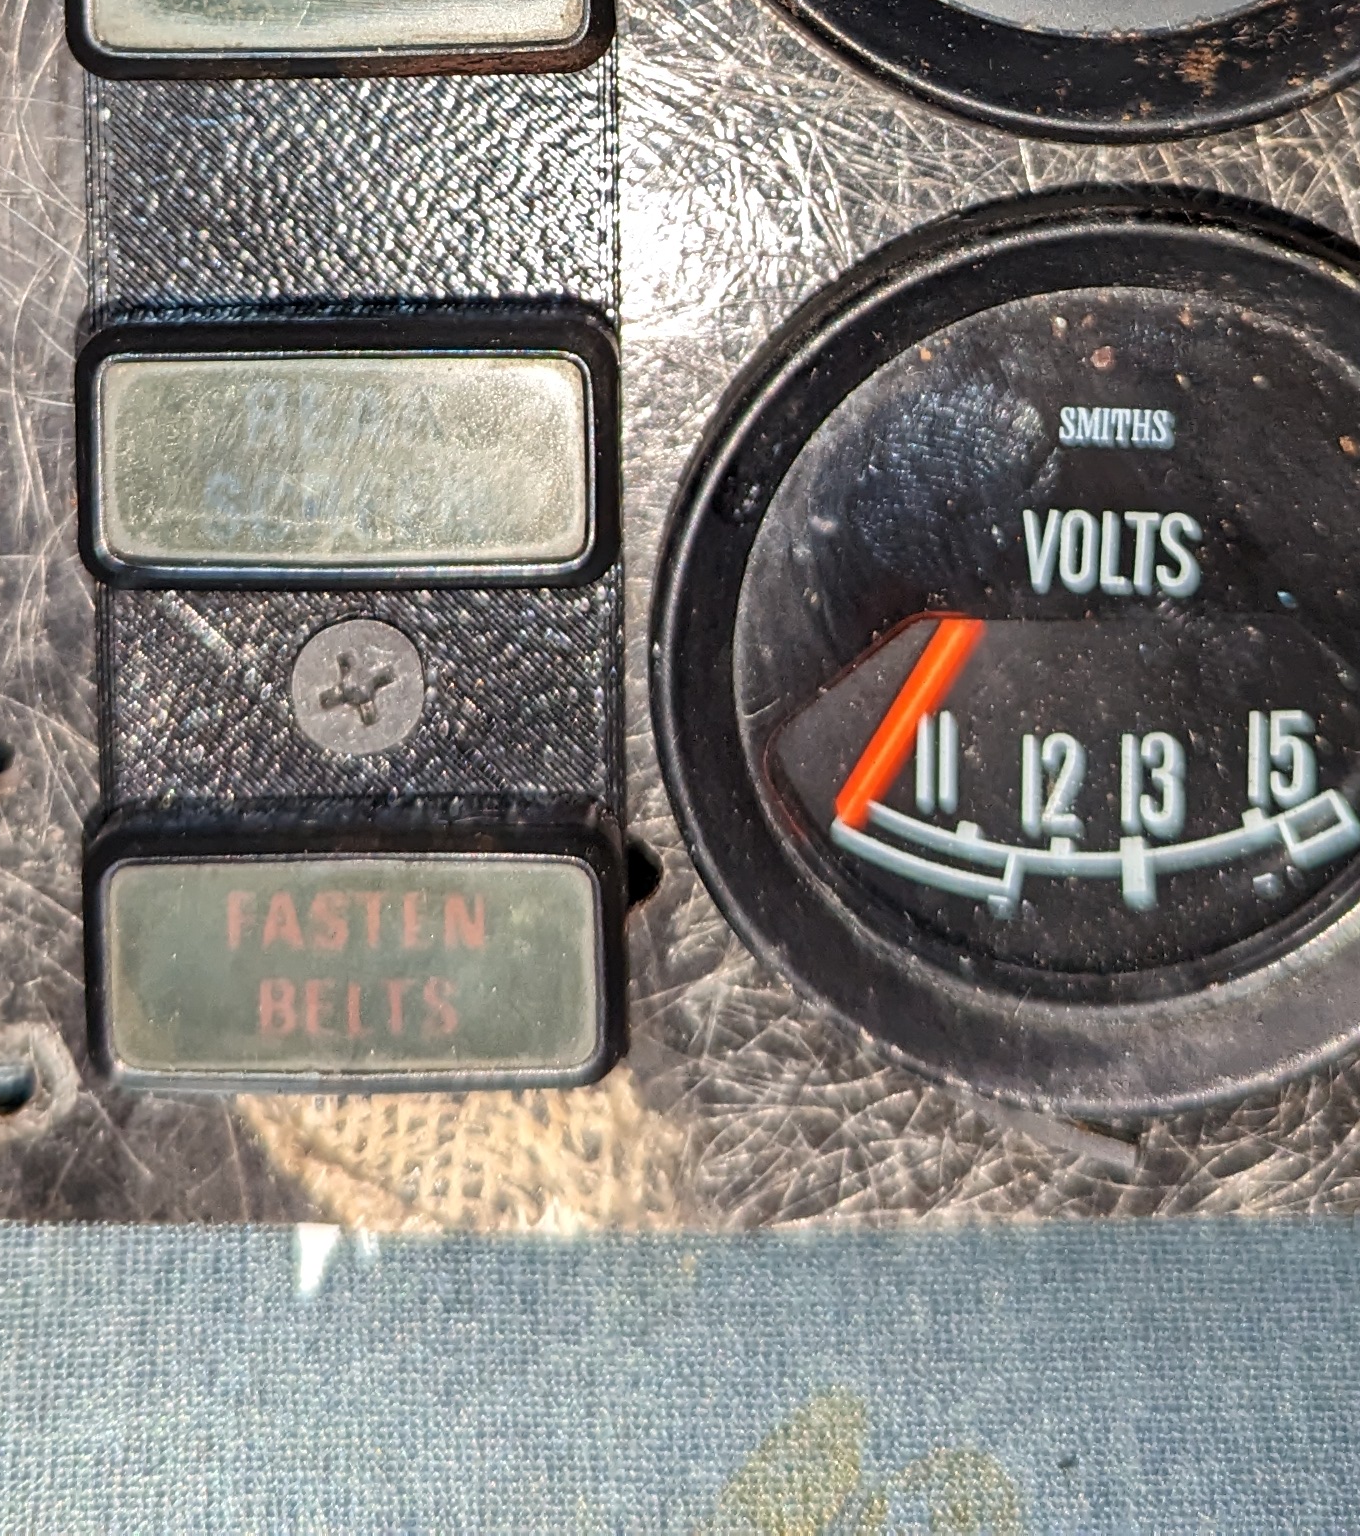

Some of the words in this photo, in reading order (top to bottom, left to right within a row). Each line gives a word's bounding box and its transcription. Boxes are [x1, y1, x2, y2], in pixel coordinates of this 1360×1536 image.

[1059, 407, 1175, 448] SMITHS
[1023, 509, 1203, 596] VOLTS
[915, 710, 958, 816] 11
[1021, 733, 1086, 838] 12
[1121, 732, 1185, 839] 13
[1248, 710, 1317, 807] 15
[226, 889, 488, 952] FASTEN
[258, 976, 460, 1041] BELTS
